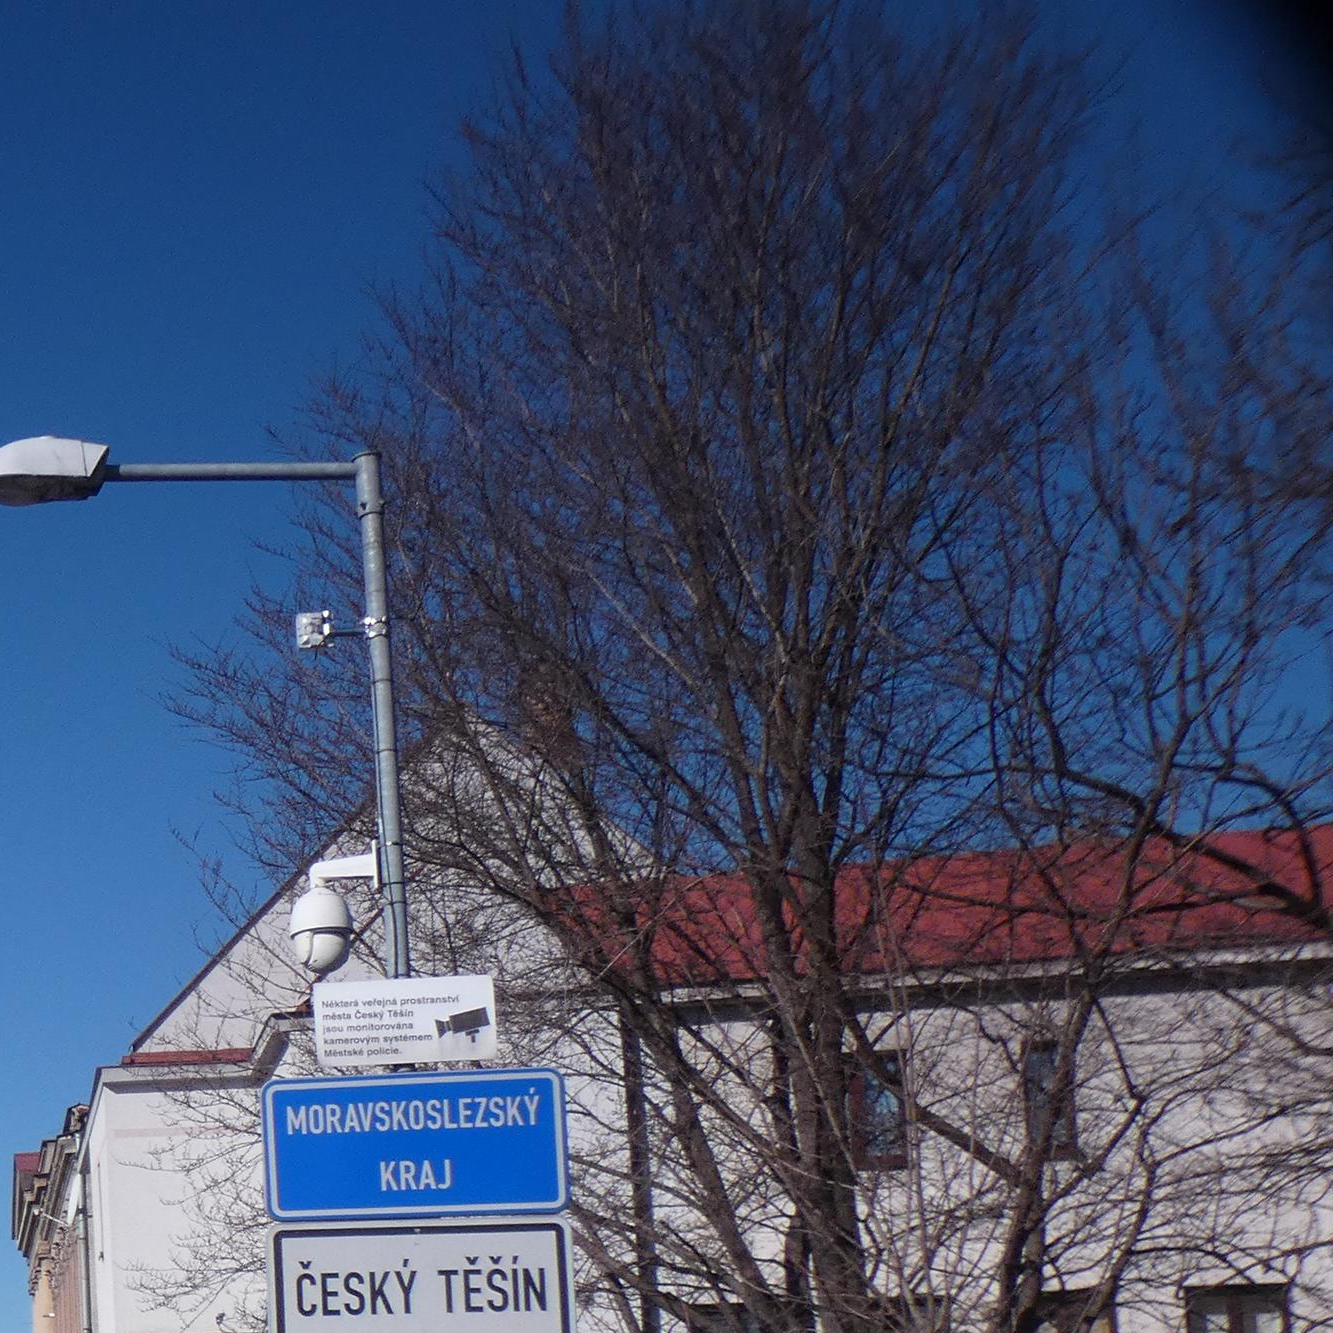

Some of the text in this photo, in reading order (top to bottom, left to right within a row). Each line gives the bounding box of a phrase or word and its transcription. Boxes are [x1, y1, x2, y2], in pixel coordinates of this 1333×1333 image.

[321, 995, 459, 1008] Některá veřejná prostranství
[322, 1008, 414, 1021] města Český Těšín
[323, 1022, 414, 1034] jsou monitorována
[323, 1033, 433, 1045] kamerovým systémem
[324, 1046, 403, 1057] Městské policie.
[286, 1087, 540, 1135] MORAVSKOSLEZSKÝ
[379, 1158, 452, 1191] KRAJ
[296, 1255, 548, 1317] ČESKÝ TĚŠÍN
